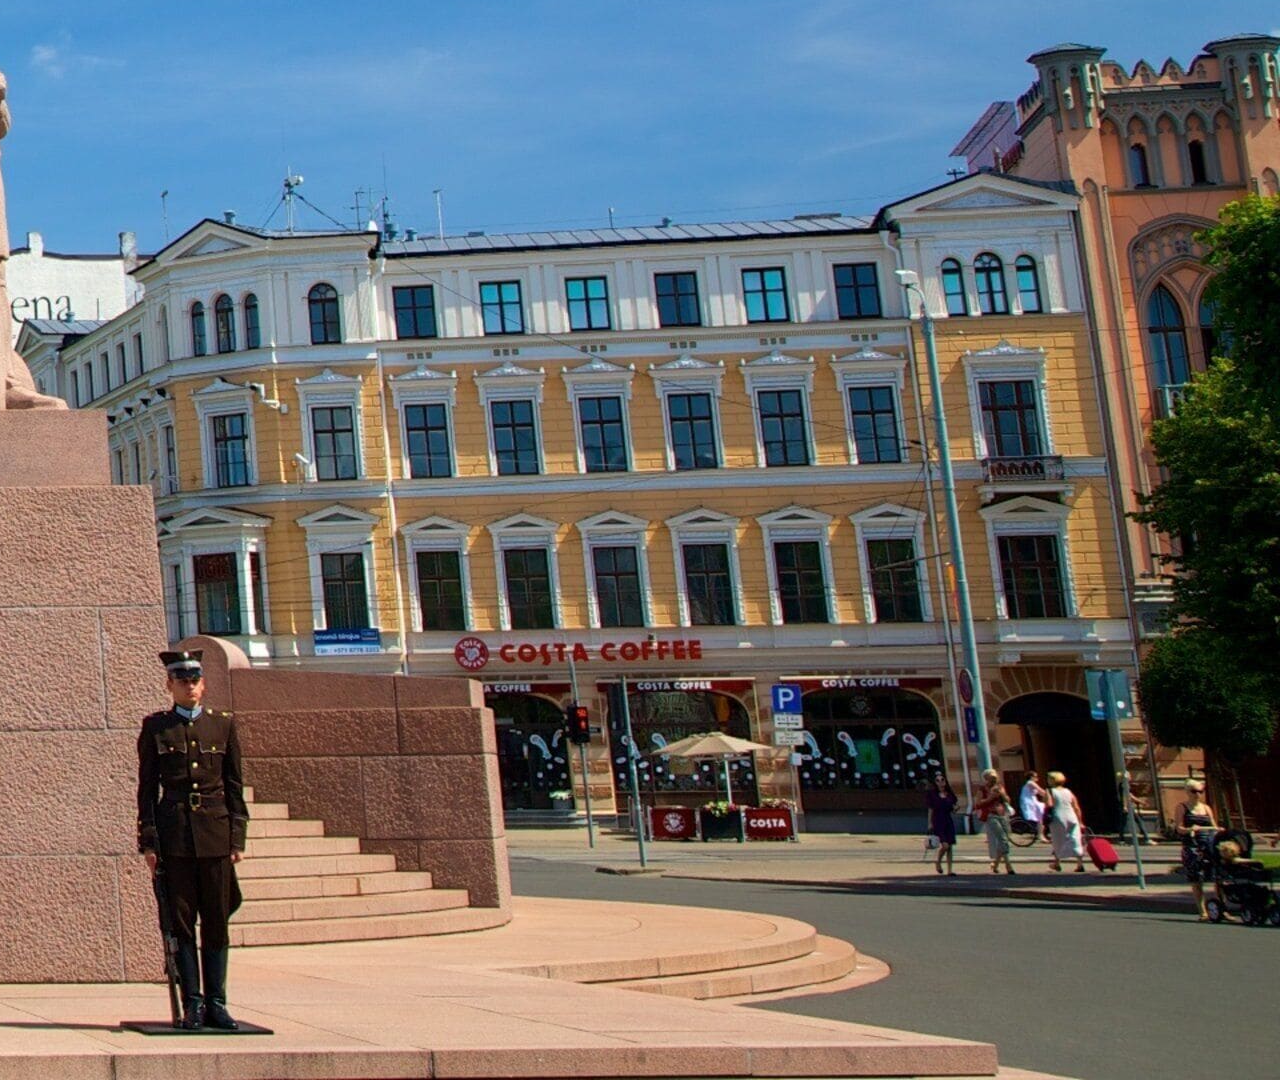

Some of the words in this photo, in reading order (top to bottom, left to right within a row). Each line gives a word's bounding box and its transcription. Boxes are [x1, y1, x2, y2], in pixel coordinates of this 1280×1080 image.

[500, 642, 589, 666] COSTA
[600, 640, 702, 662] COFFEE
[494, 683, 531, 692] COFFEE
[637, 682, 670, 691] COSTA
[674, 681, 712, 690] COFFEE
[822, 680, 856, 688] COSTA
[860, 679, 899, 687] COFFEE
[778, 688, 794, 709] P
[750, 818, 786, 828] COSTA
